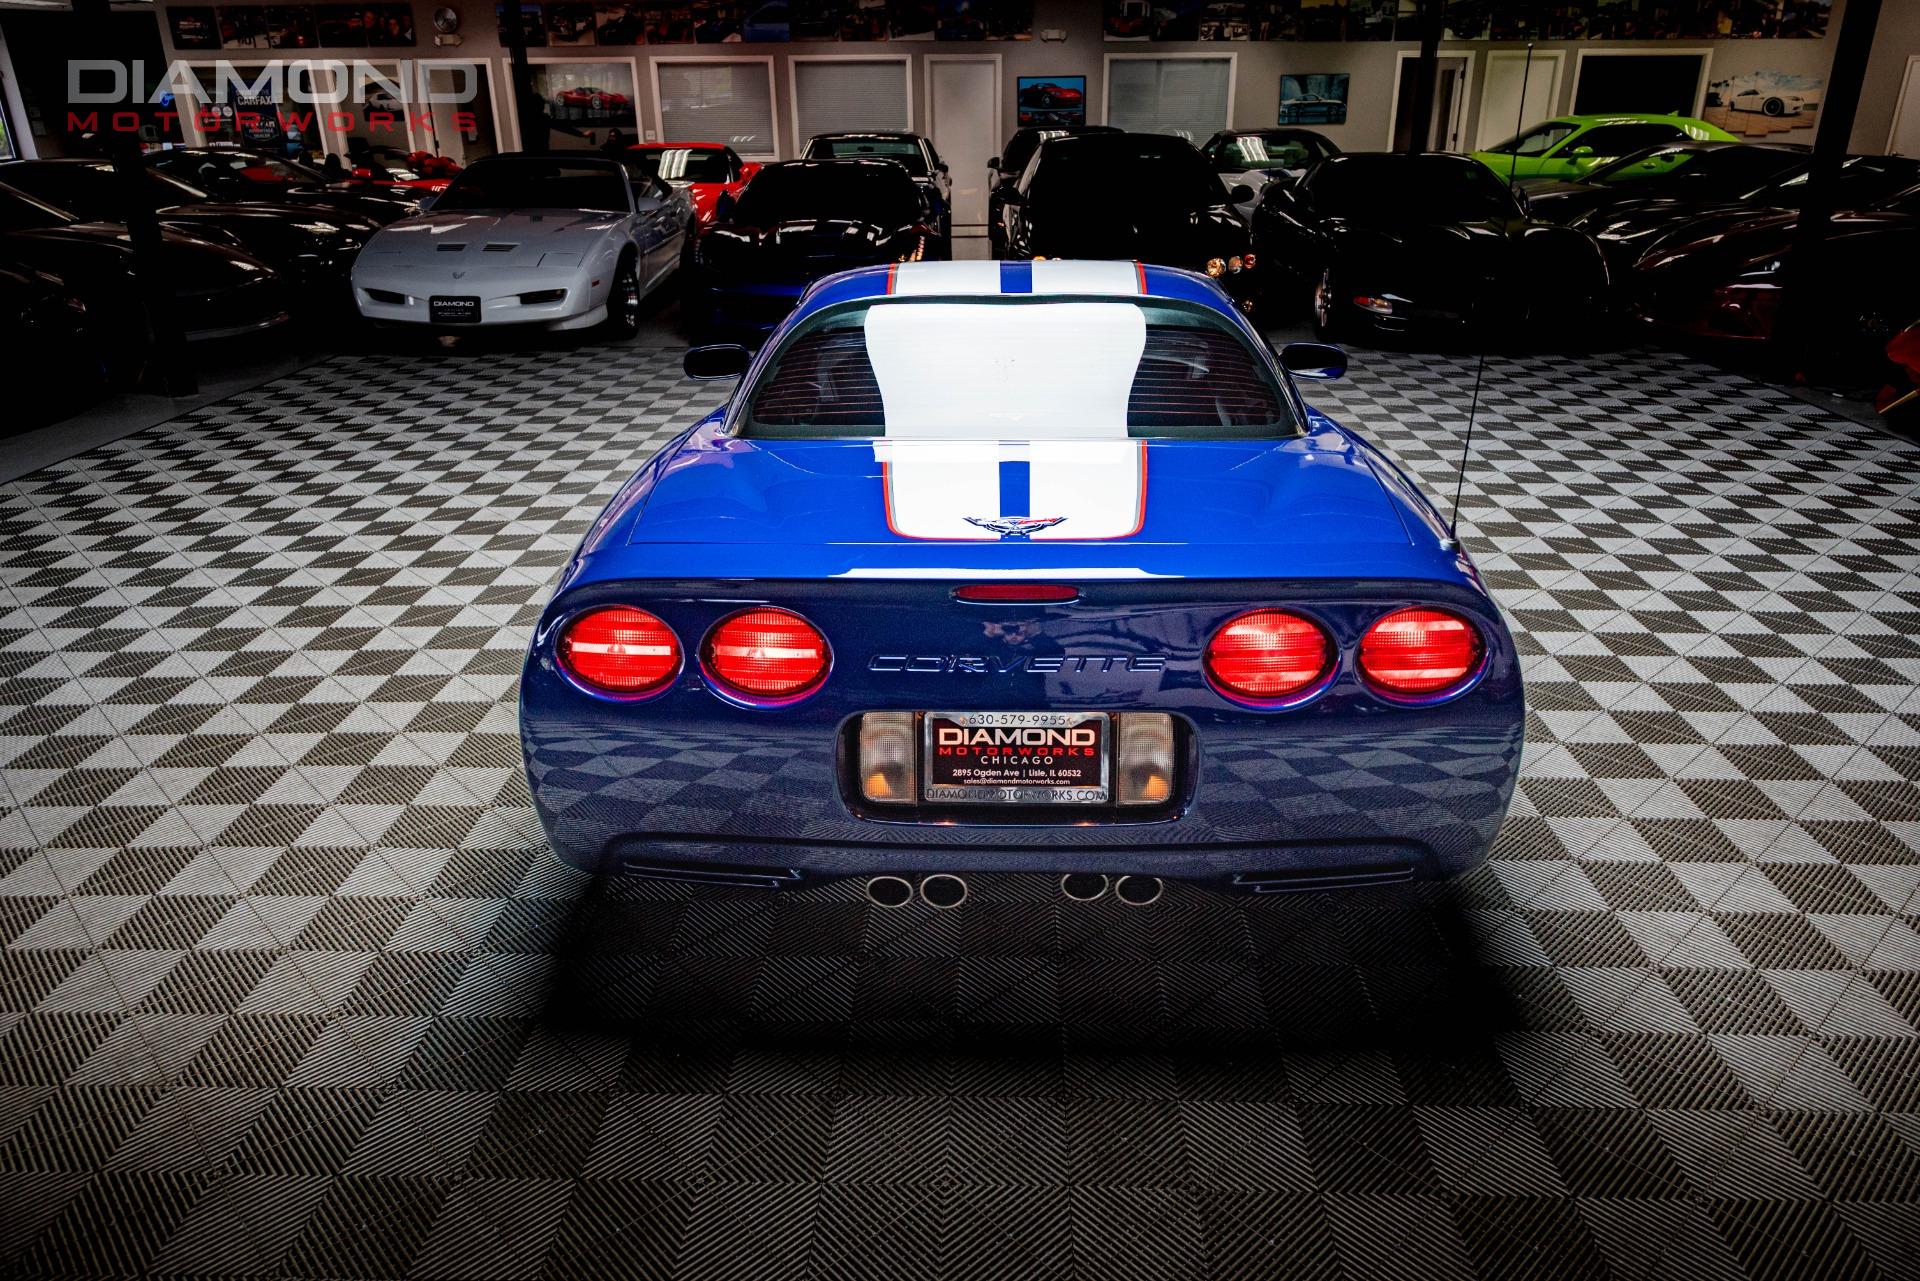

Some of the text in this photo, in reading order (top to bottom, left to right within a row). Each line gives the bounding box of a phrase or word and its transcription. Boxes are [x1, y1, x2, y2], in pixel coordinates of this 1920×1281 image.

[867, 654, 1168, 673] CORVETTE
[969, 714, 1066, 726] 630-579-9955
[938, 728, 1096, 746] DIAMOND
[938, 747, 1095, 756] MOTORWORKS
[980, 756, 1054, 765] CHICAGO
[952, 769, 1082, 778] 2895 Ogden Ave Lisle, IL 60532
[963, 778, 1071, 786] sales@diamondmotorworks.com
[926, 788, 1108, 801] DIAMONDMOTORWORKS.COM
